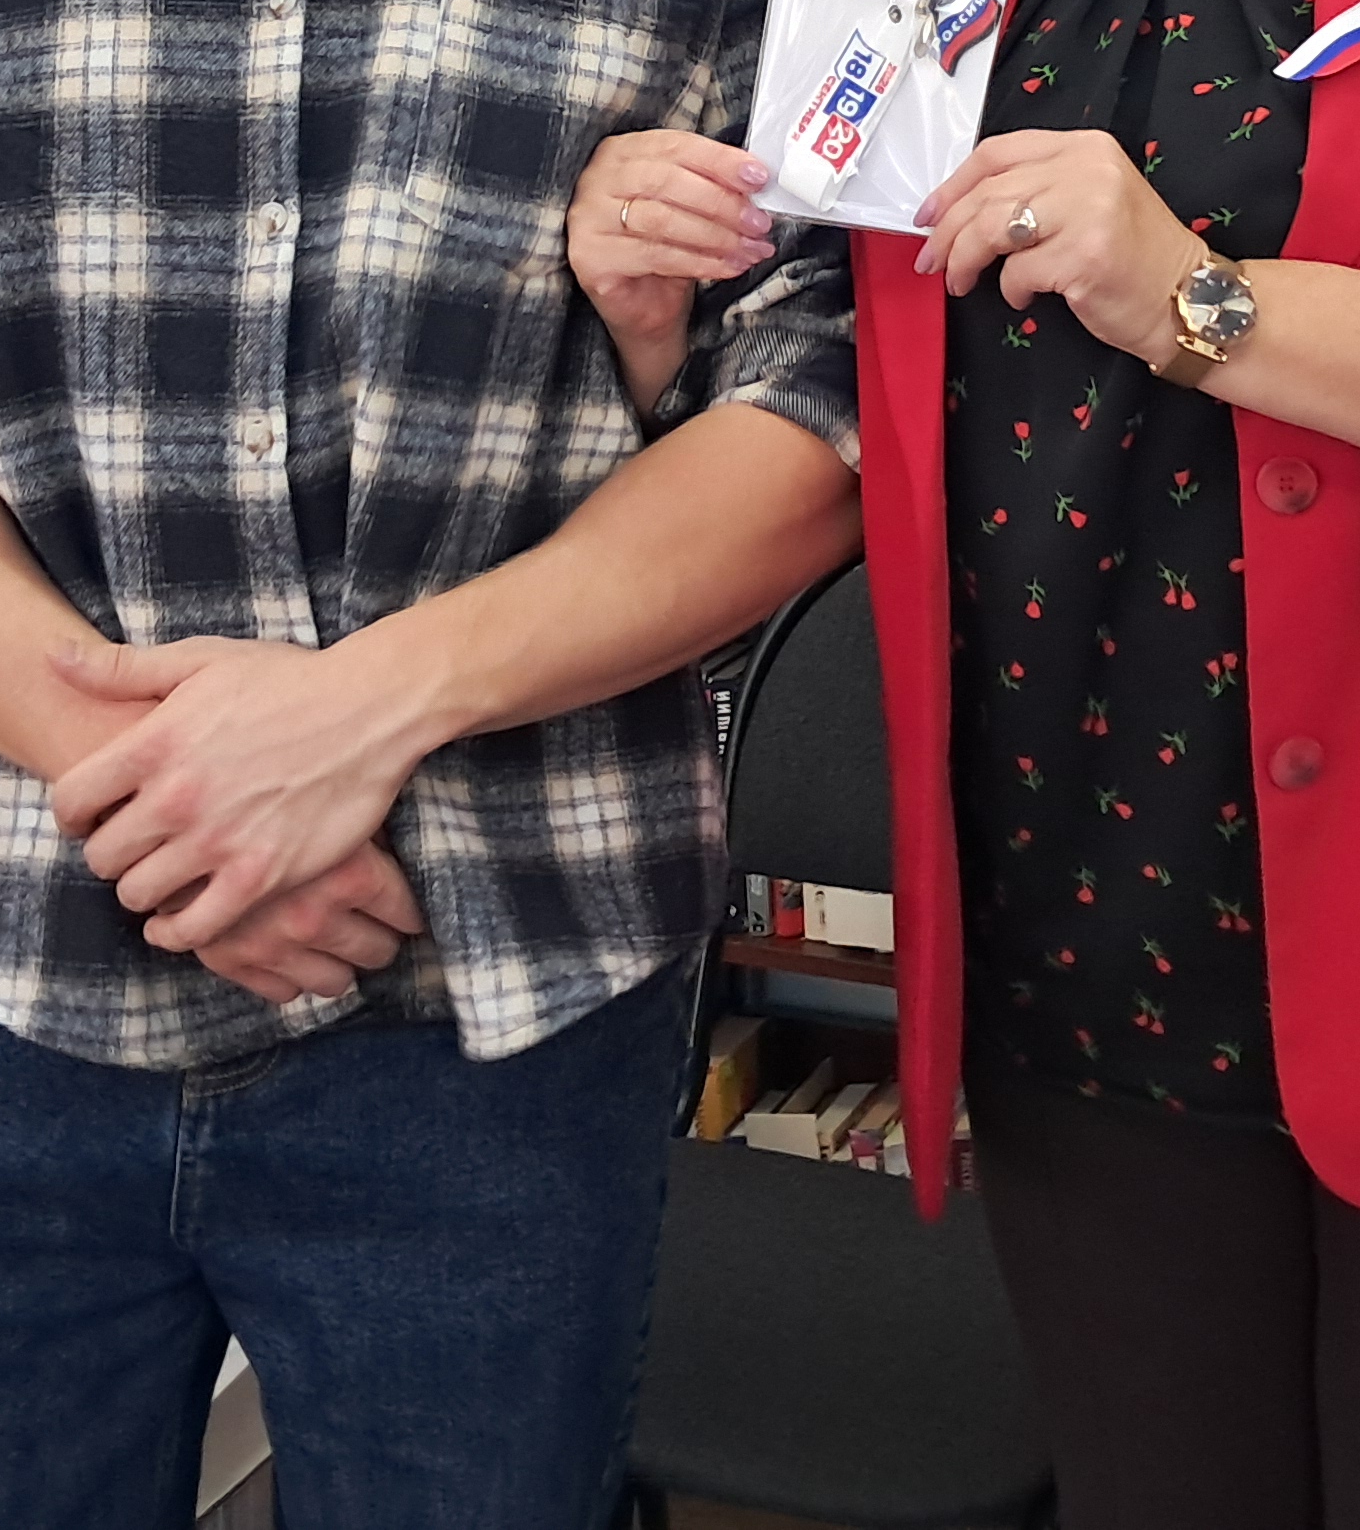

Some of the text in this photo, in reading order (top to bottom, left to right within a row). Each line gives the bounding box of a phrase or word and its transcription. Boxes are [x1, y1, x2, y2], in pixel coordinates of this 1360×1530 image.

[844, 49, 874, 80] 18
[835, 86, 867, 119] 19
[820, 119, 857, 161] 20
